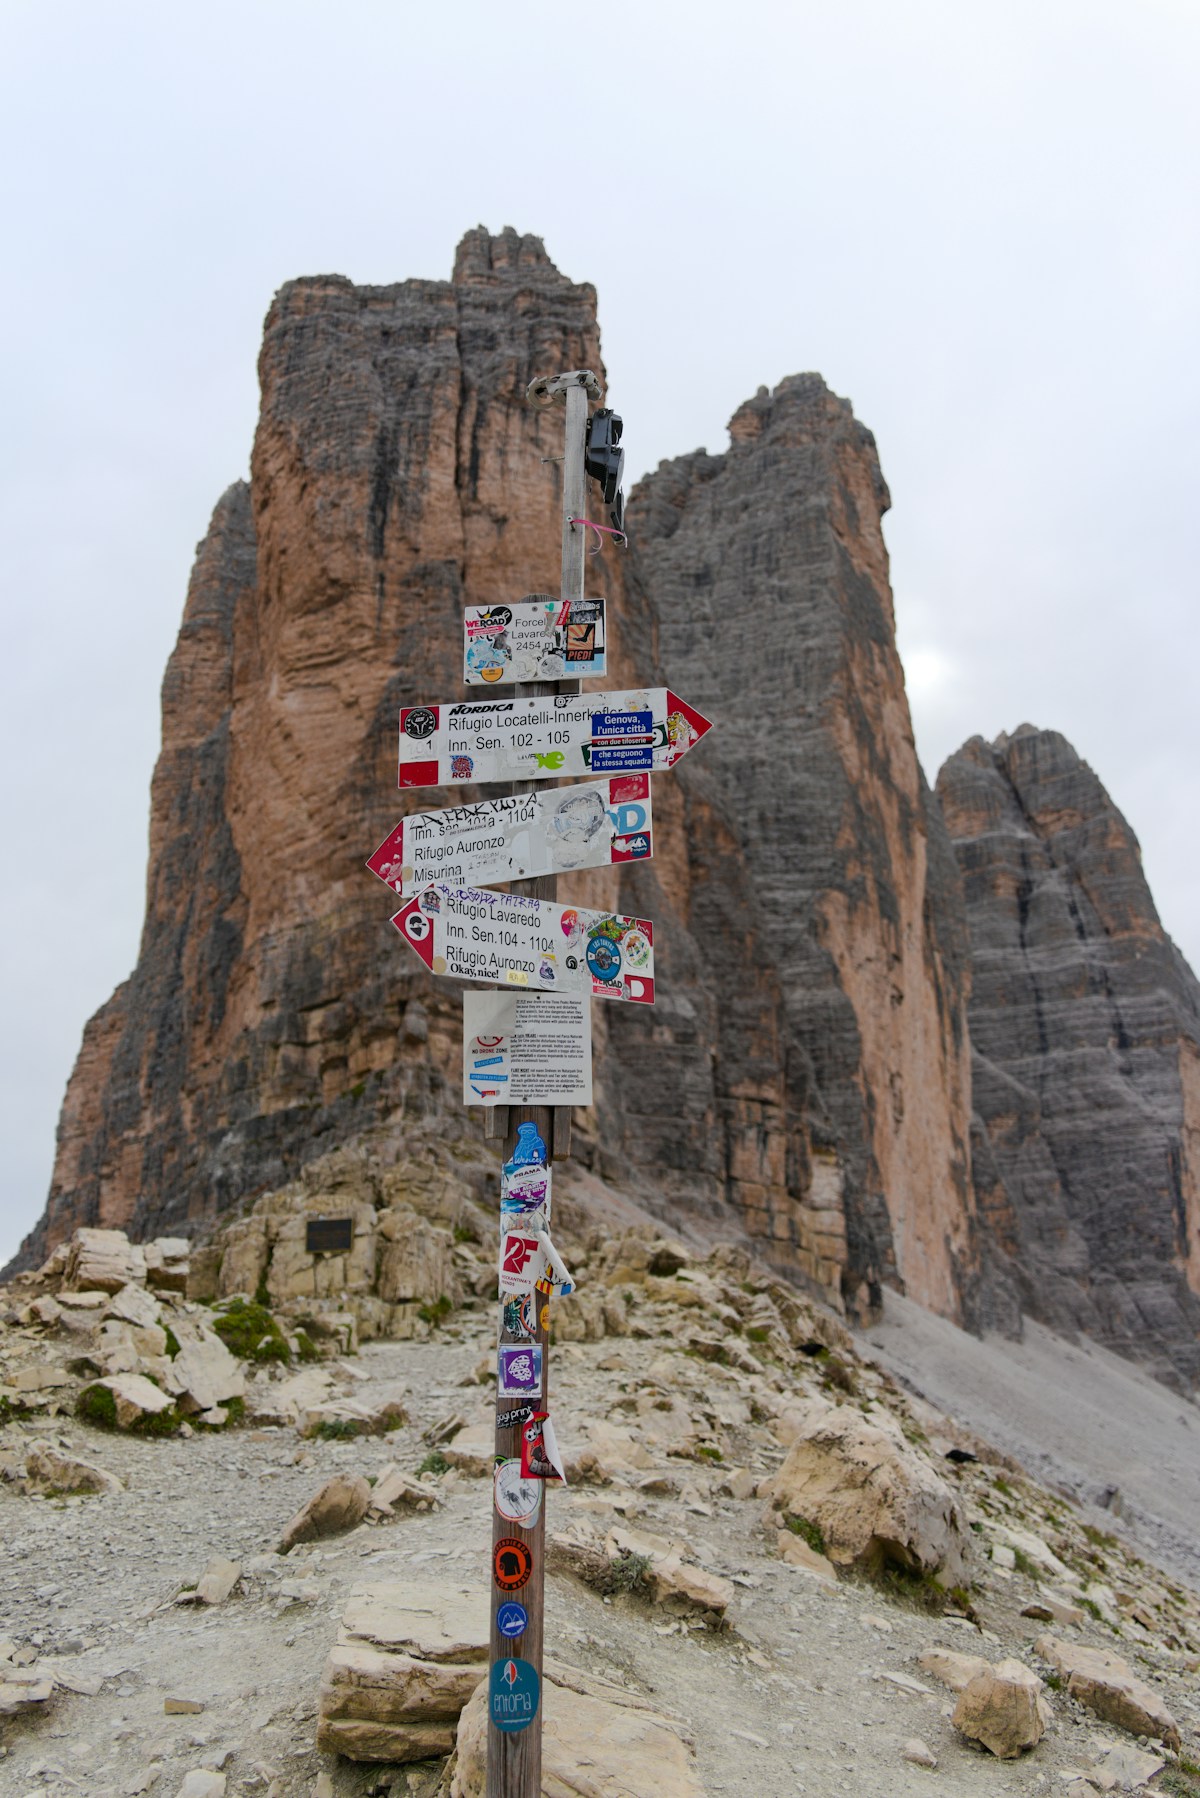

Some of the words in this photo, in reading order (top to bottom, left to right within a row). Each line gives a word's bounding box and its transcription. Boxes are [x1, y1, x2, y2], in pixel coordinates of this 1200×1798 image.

[465, 618, 505, 628] WEROAD
[515, 617, 546, 628] Forcel
[511, 629, 557, 640] Lavareo
[516, 641, 541, 650] 2454
[544, 642, 553, 651] m
[448, 703, 514, 716] NORDICA
[448, 716, 493, 732] Rifugio
[604, 715, 640, 725] Genova,
[597, 726, 625, 735] l'unica
[626, 724, 646, 734] città
[448, 739, 471, 752] Inn.
[476, 736, 505, 750] Sen.
[510, 733, 533, 747] 102
[547, 730, 570, 745] 105
[611, 750, 643, 759] seguono
[601, 759, 623, 767] stessa
[624, 757, 651, 766] squadra
[452, 771, 472, 779] RCB
[507, 807, 535, 824] 1104
[414, 845, 454, 861] Rifugio
[455, 836, 505, 855] Auronzo
[414, 864, 462, 883] Misurina
[446, 898, 487, 920] Rifugio
[490, 905, 542, 928] Lavaredo
[446, 921, 468, 939] Inn.
[529, 935, 555, 953] 1104
[446, 945, 483, 968] Rifugio
[489, 952, 536, 973] Auronzo
[450, 963, 477, 977] Okay,
[478, 966, 500, 979] nice!
[529, 1459, 557, 1476] BERL
